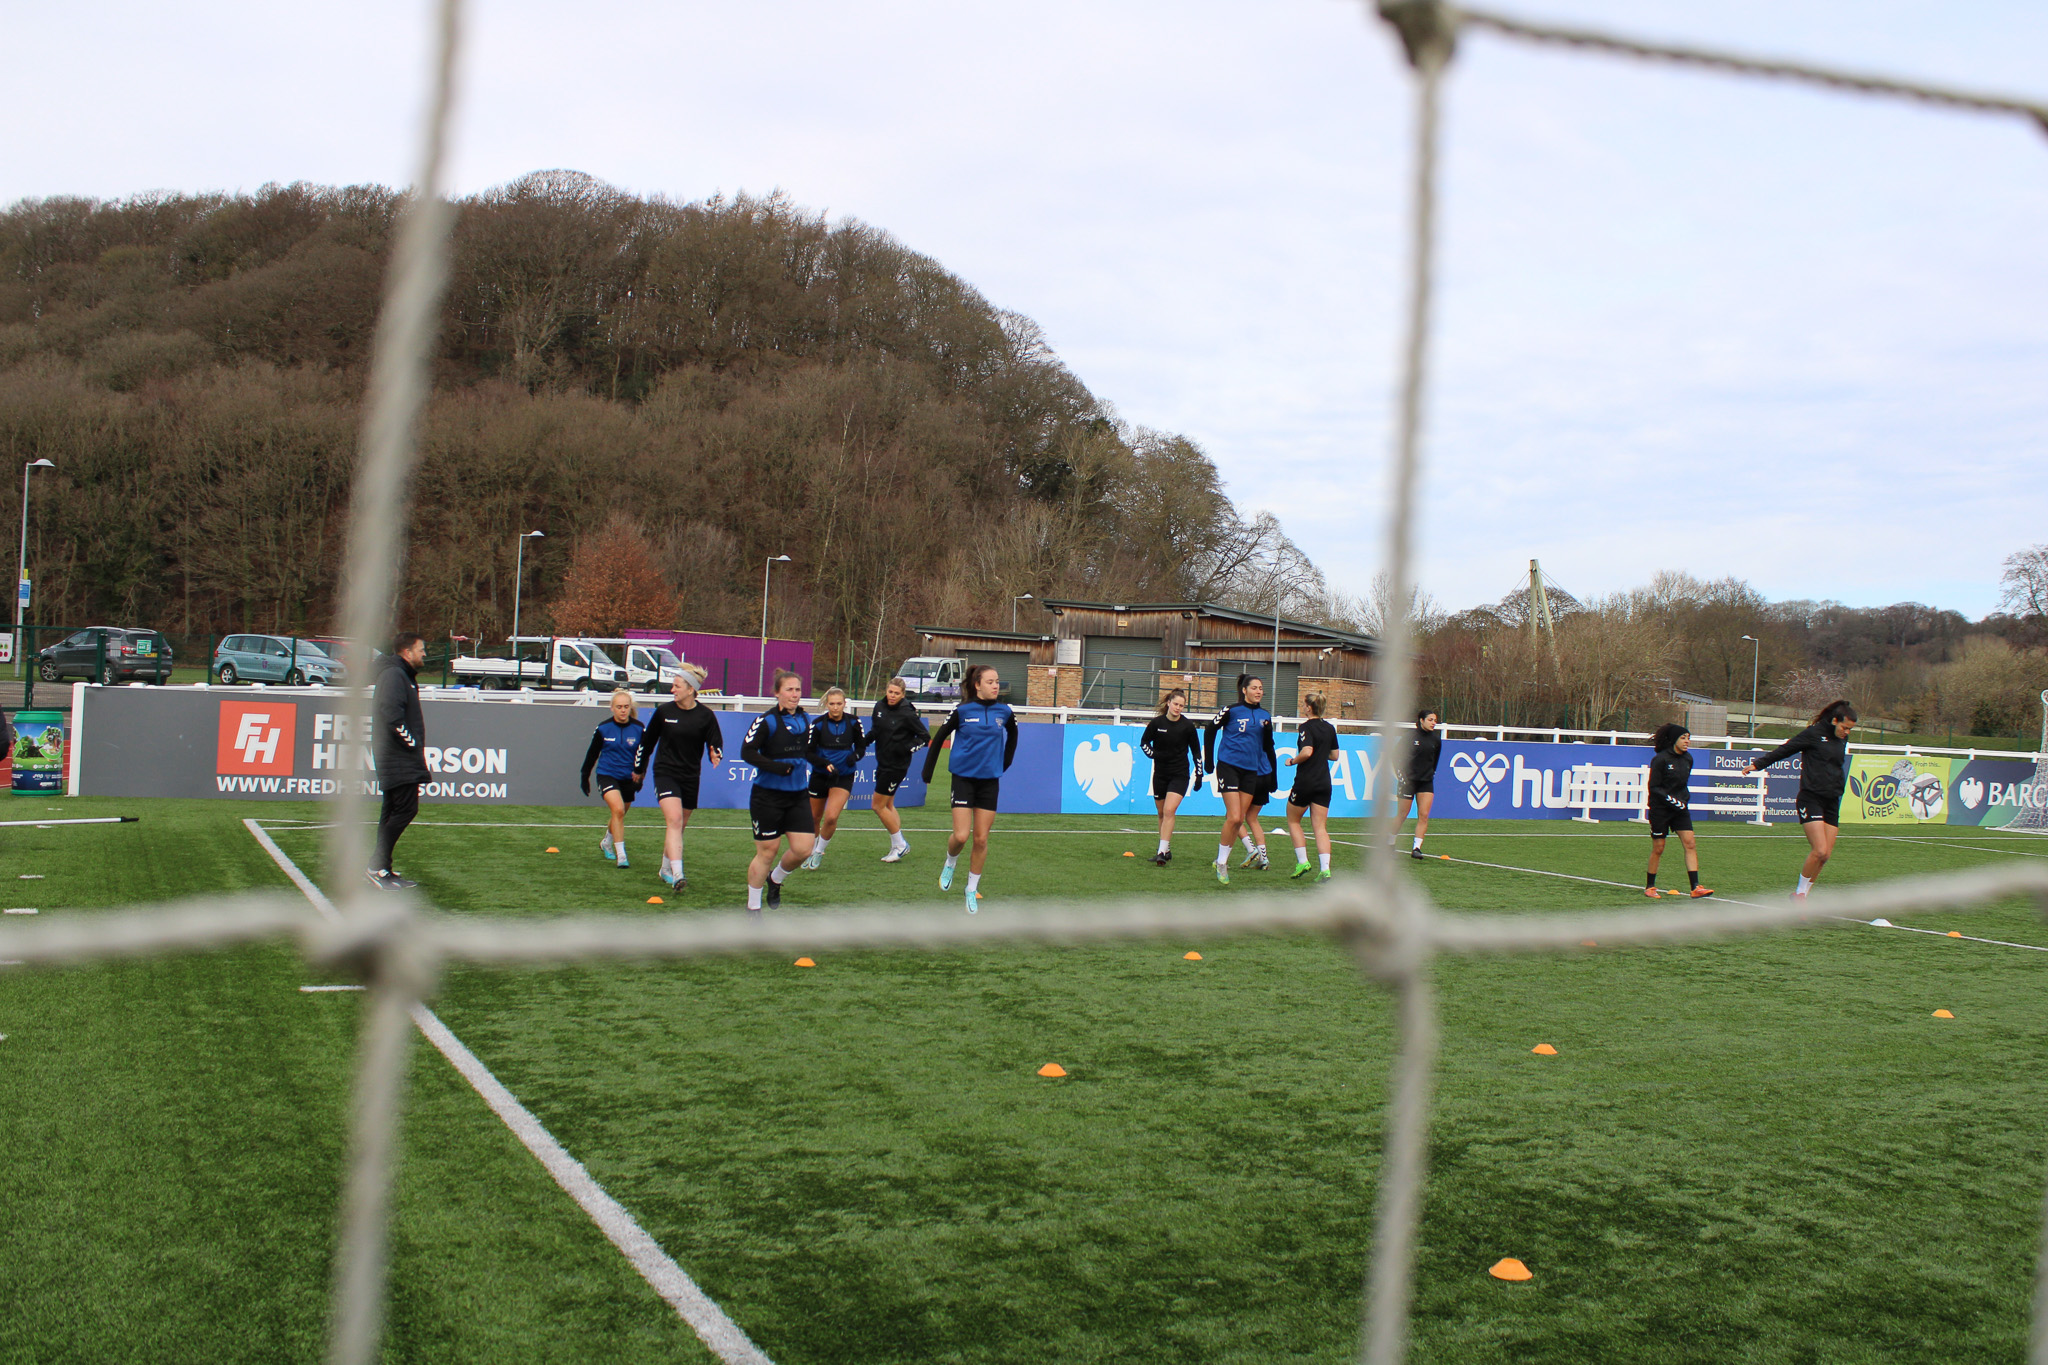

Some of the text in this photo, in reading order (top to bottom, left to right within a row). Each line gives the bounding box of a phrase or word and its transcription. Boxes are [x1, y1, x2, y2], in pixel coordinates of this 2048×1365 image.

[234, 713, 281, 764] FH
[314, 713, 373, 742] FRE
[1715, 756, 1747, 768] Plastic
[1869, 776, 1896, 801] Go
[1987, 782, 2048, 808] BARC
[1867, 800, 1900, 818] GREEN
